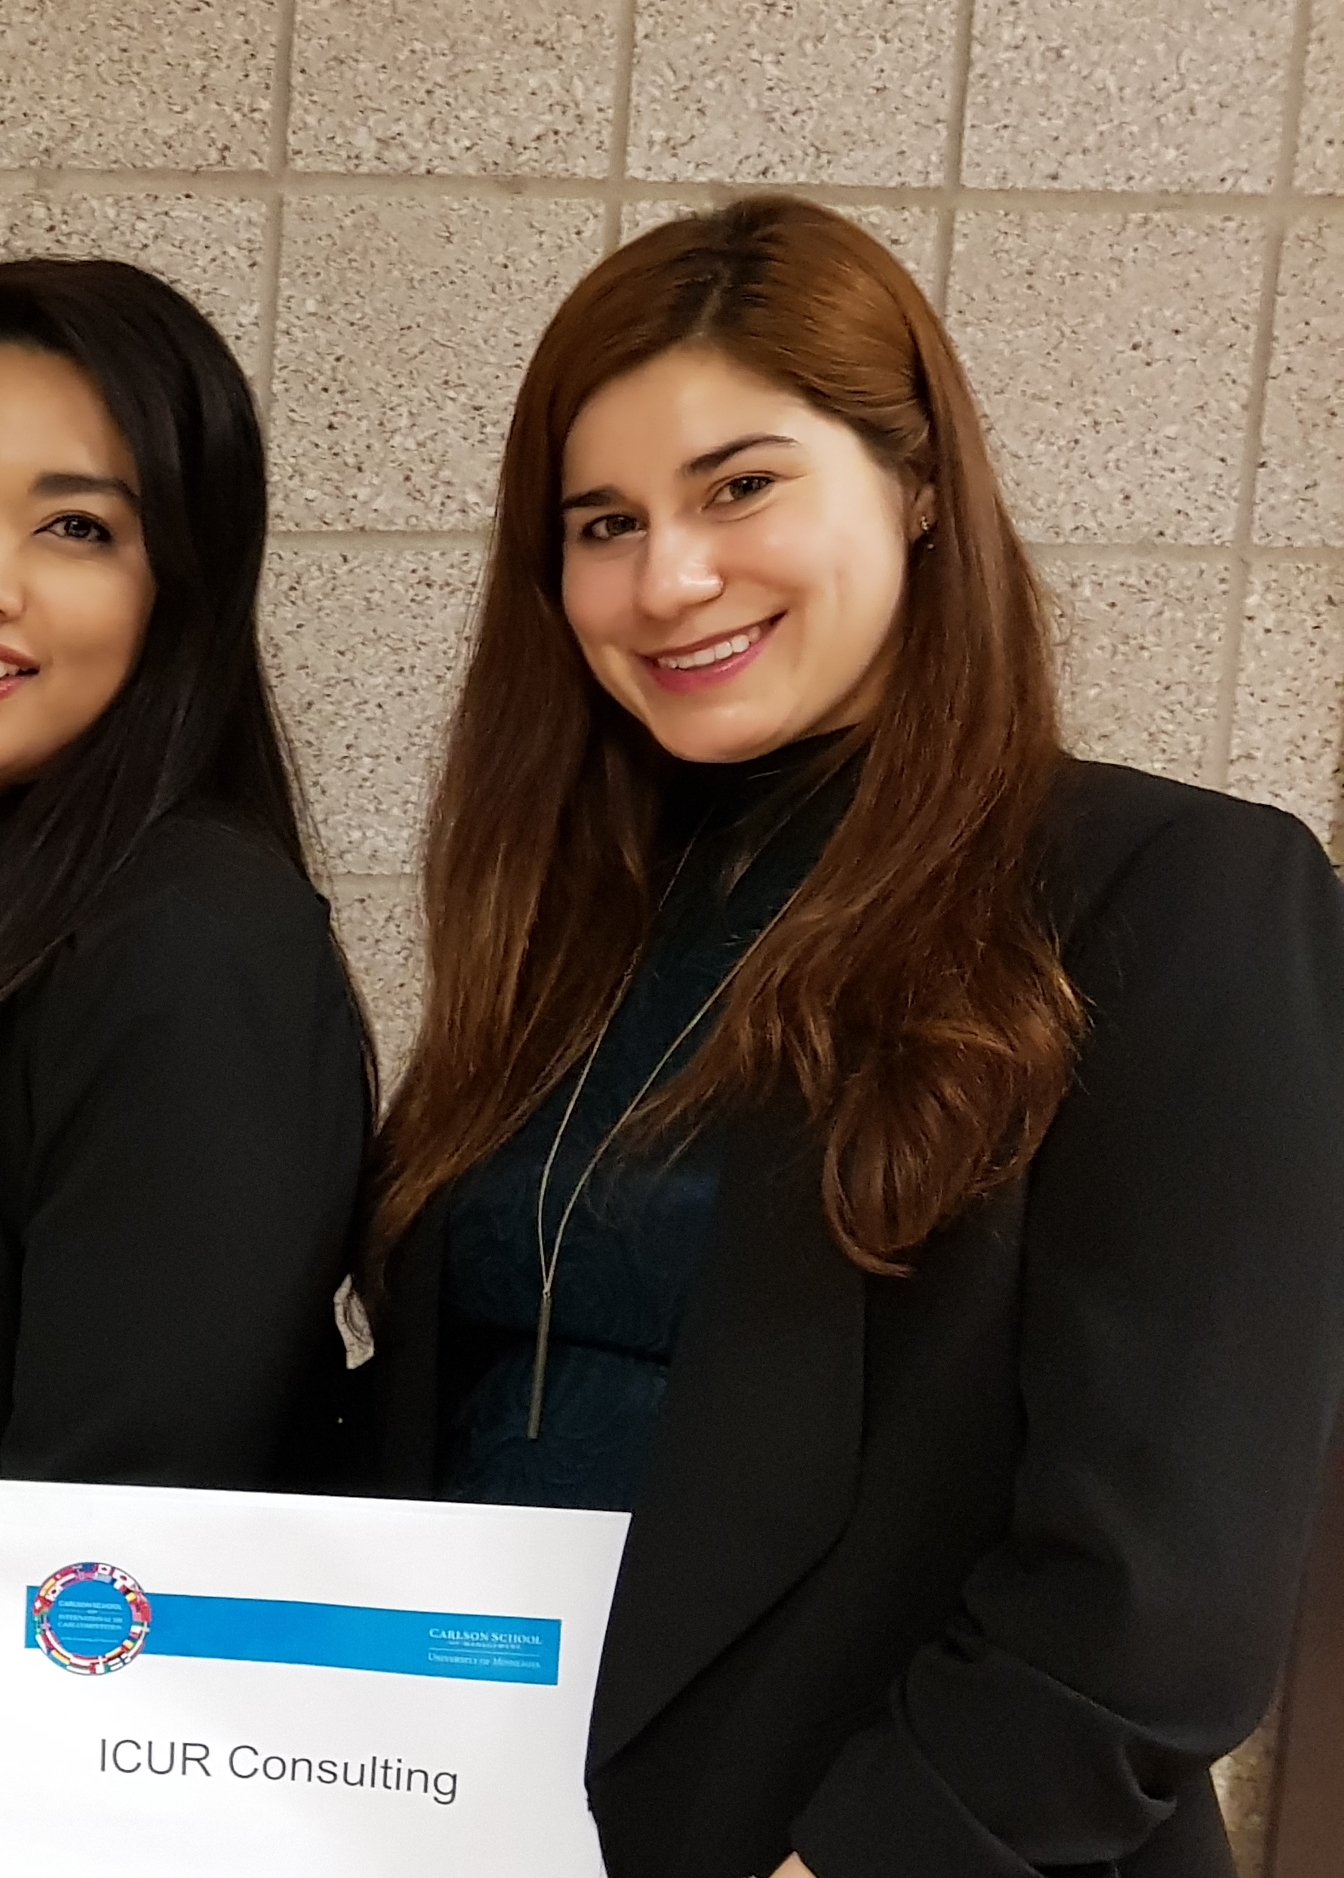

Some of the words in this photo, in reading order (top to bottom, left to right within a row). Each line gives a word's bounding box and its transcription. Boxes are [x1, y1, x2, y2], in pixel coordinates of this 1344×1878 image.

[429, 1628, 489, 1642] CARLSON
[491, 1631, 542, 1645] SCHOOL
[100, 1738, 212, 1777] ICUR
[228, 1745, 458, 1805] Consulting
